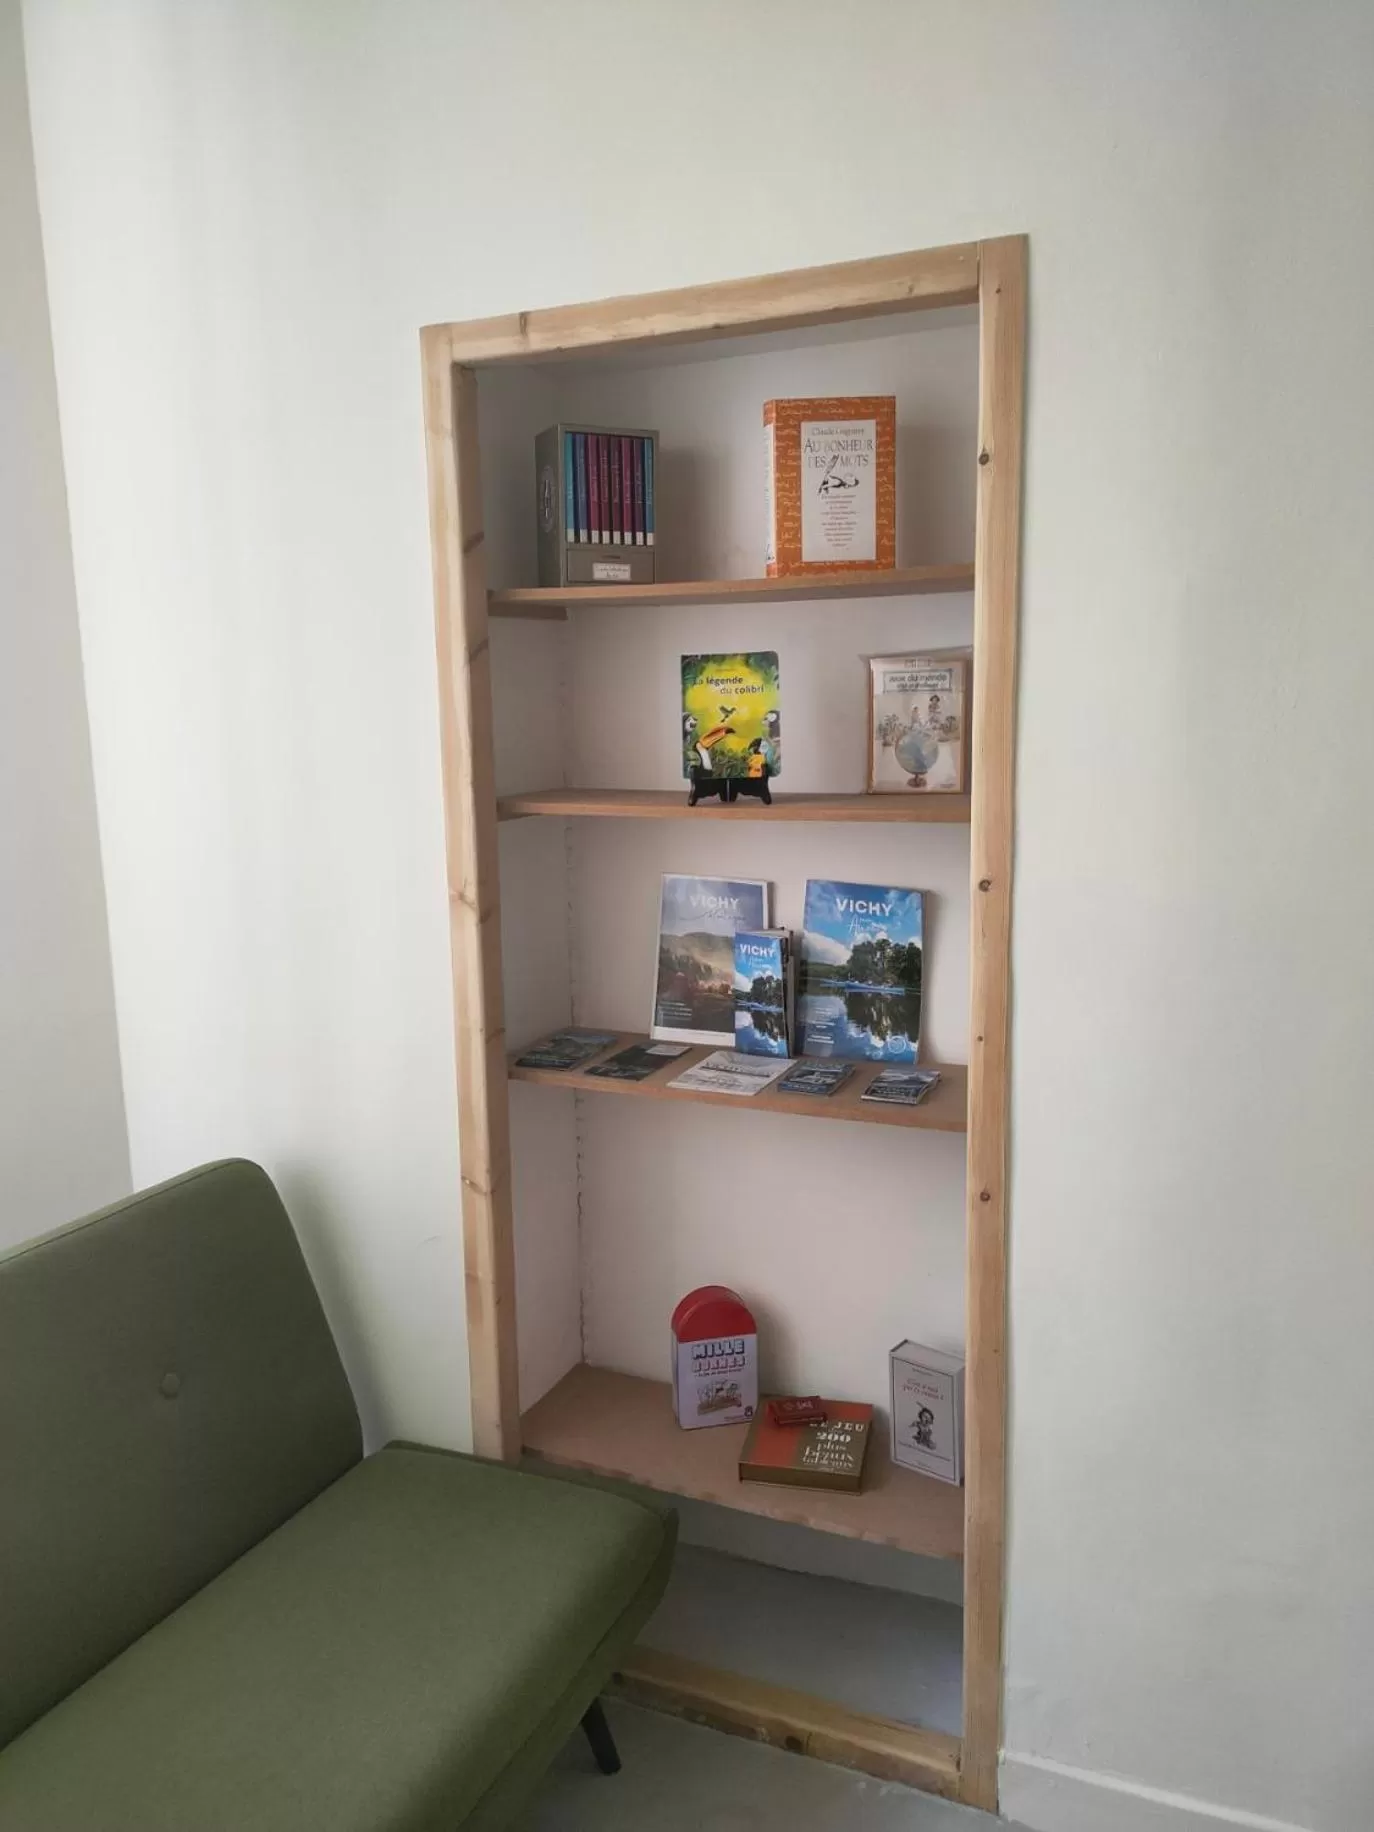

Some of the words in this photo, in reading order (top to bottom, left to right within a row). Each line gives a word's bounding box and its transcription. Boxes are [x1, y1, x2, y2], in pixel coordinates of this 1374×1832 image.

[804, 438, 821, 453] AU
[839, 454, 869, 468] MOTS
[706, 676, 744, 687] légende
[735, 684, 765, 695] colibri
[689, 895, 740, 909] VICHY
[836, 897, 893, 917] VICHY
[739, 943, 775, 958] VICHY
[692, 1339, 745, 1360] MILLE
[833, 1421, 865, 1432] JEU
[816, 1432, 852, 1444] 200
[817, 1441, 847, 1451] plus
